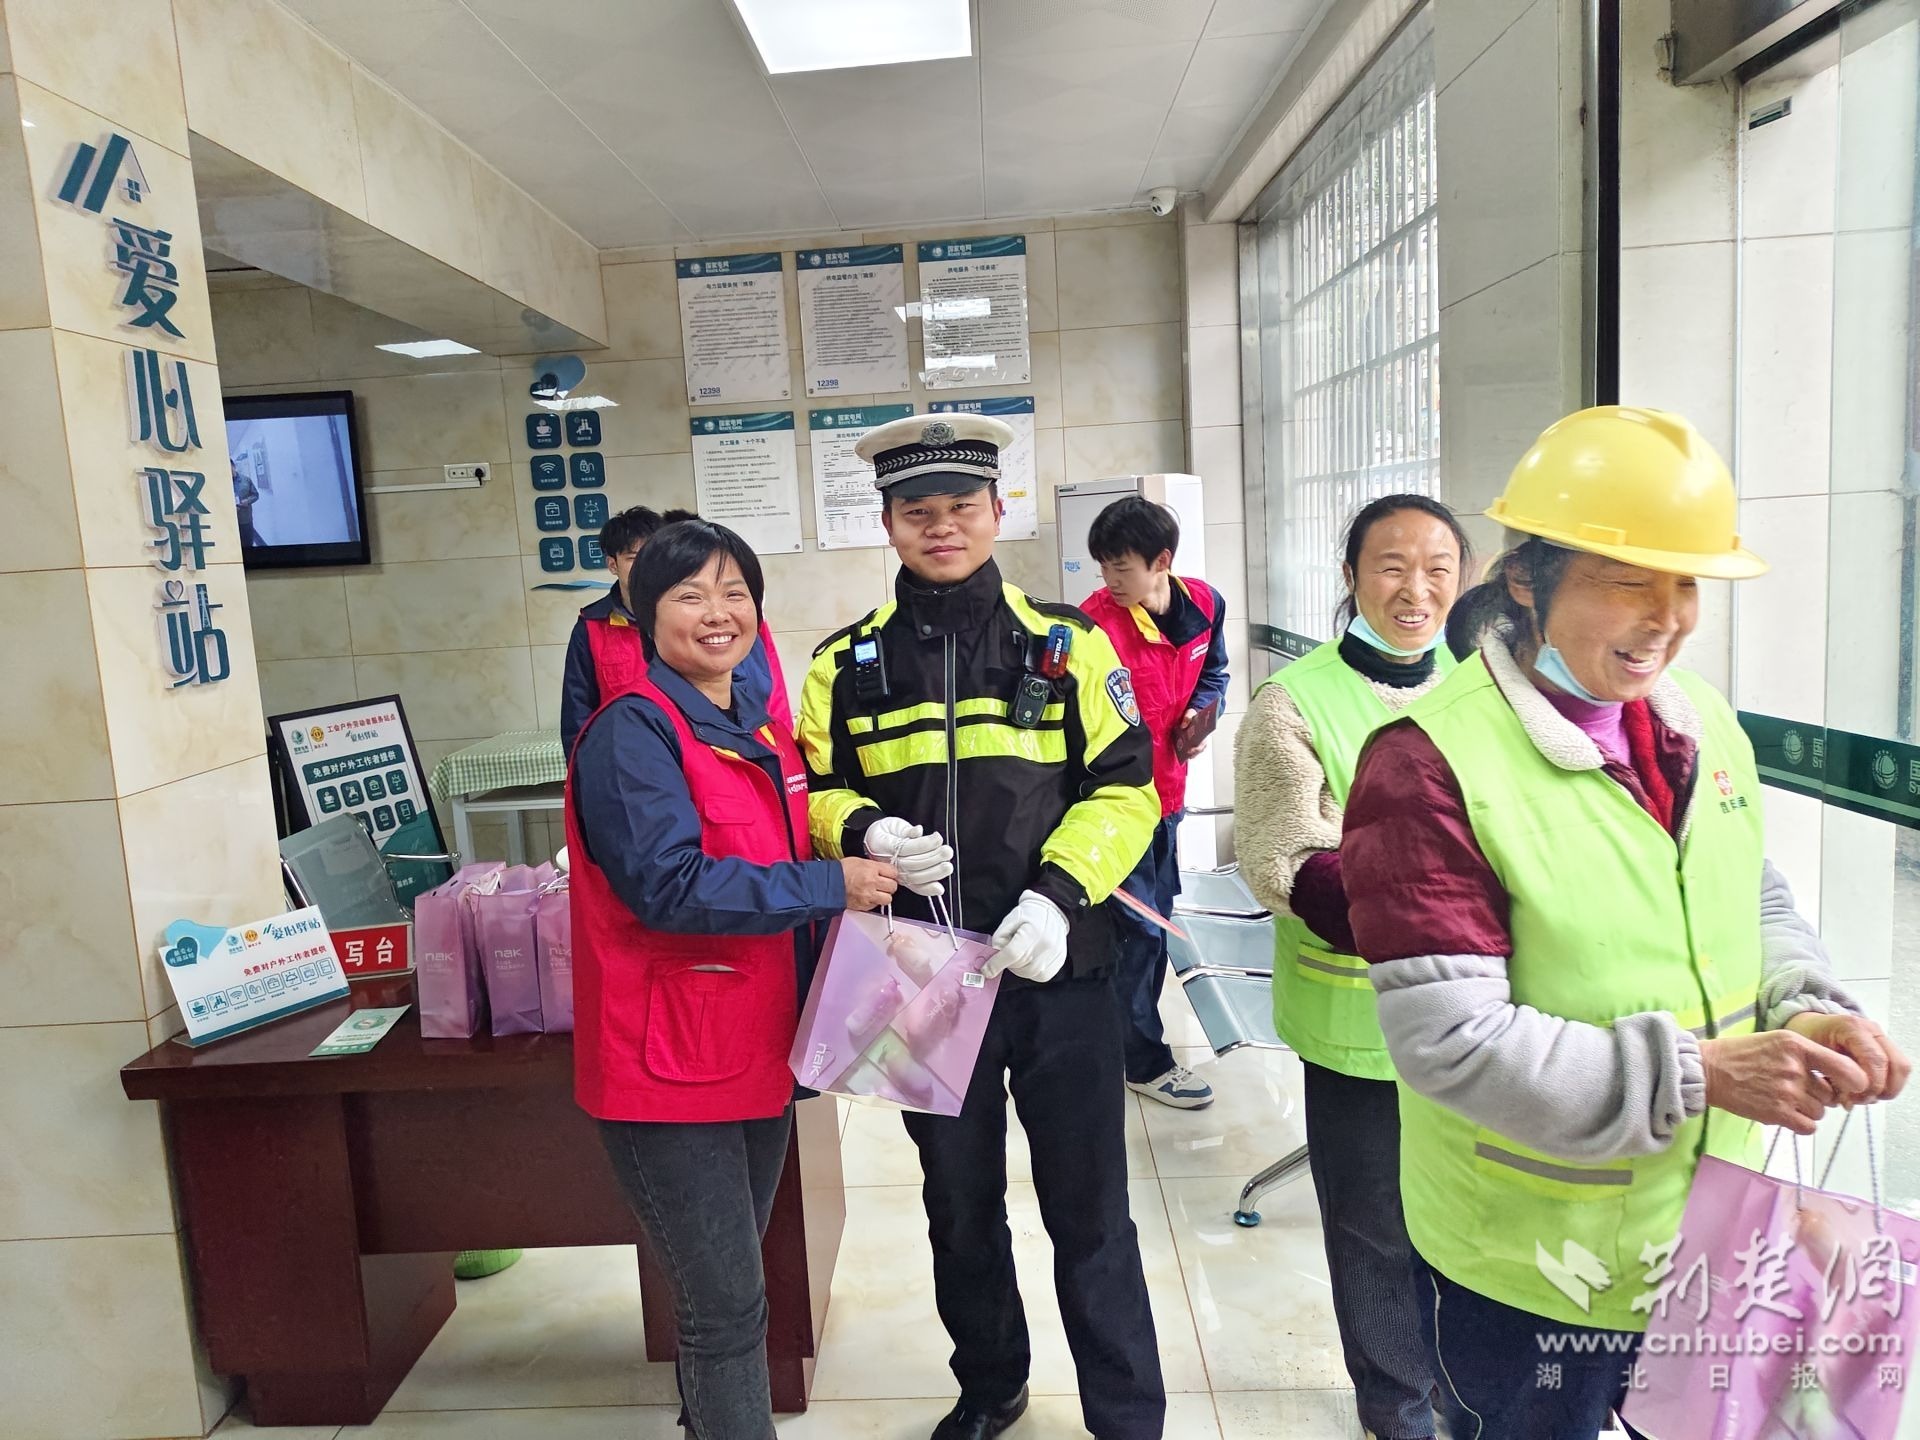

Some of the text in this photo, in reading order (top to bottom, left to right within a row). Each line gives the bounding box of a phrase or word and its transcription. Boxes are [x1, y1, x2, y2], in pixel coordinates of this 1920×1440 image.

[699, 387, 721, 395] 12398
[817, 379, 839, 388] 12398
[111, 216, 229, 687] 爱心驿站
[1053, 637, 1063, 664] POLICE
[312, 750, 397, 778] 免费对户外工作者提供
[243, 945, 328, 977] 免费对户外工作者提供
[345, 936, 394, 968] 写台
[425, 952, 454, 961] nak
[494, 948, 522, 959] nak
[809, 1042, 828, 1078] nak
